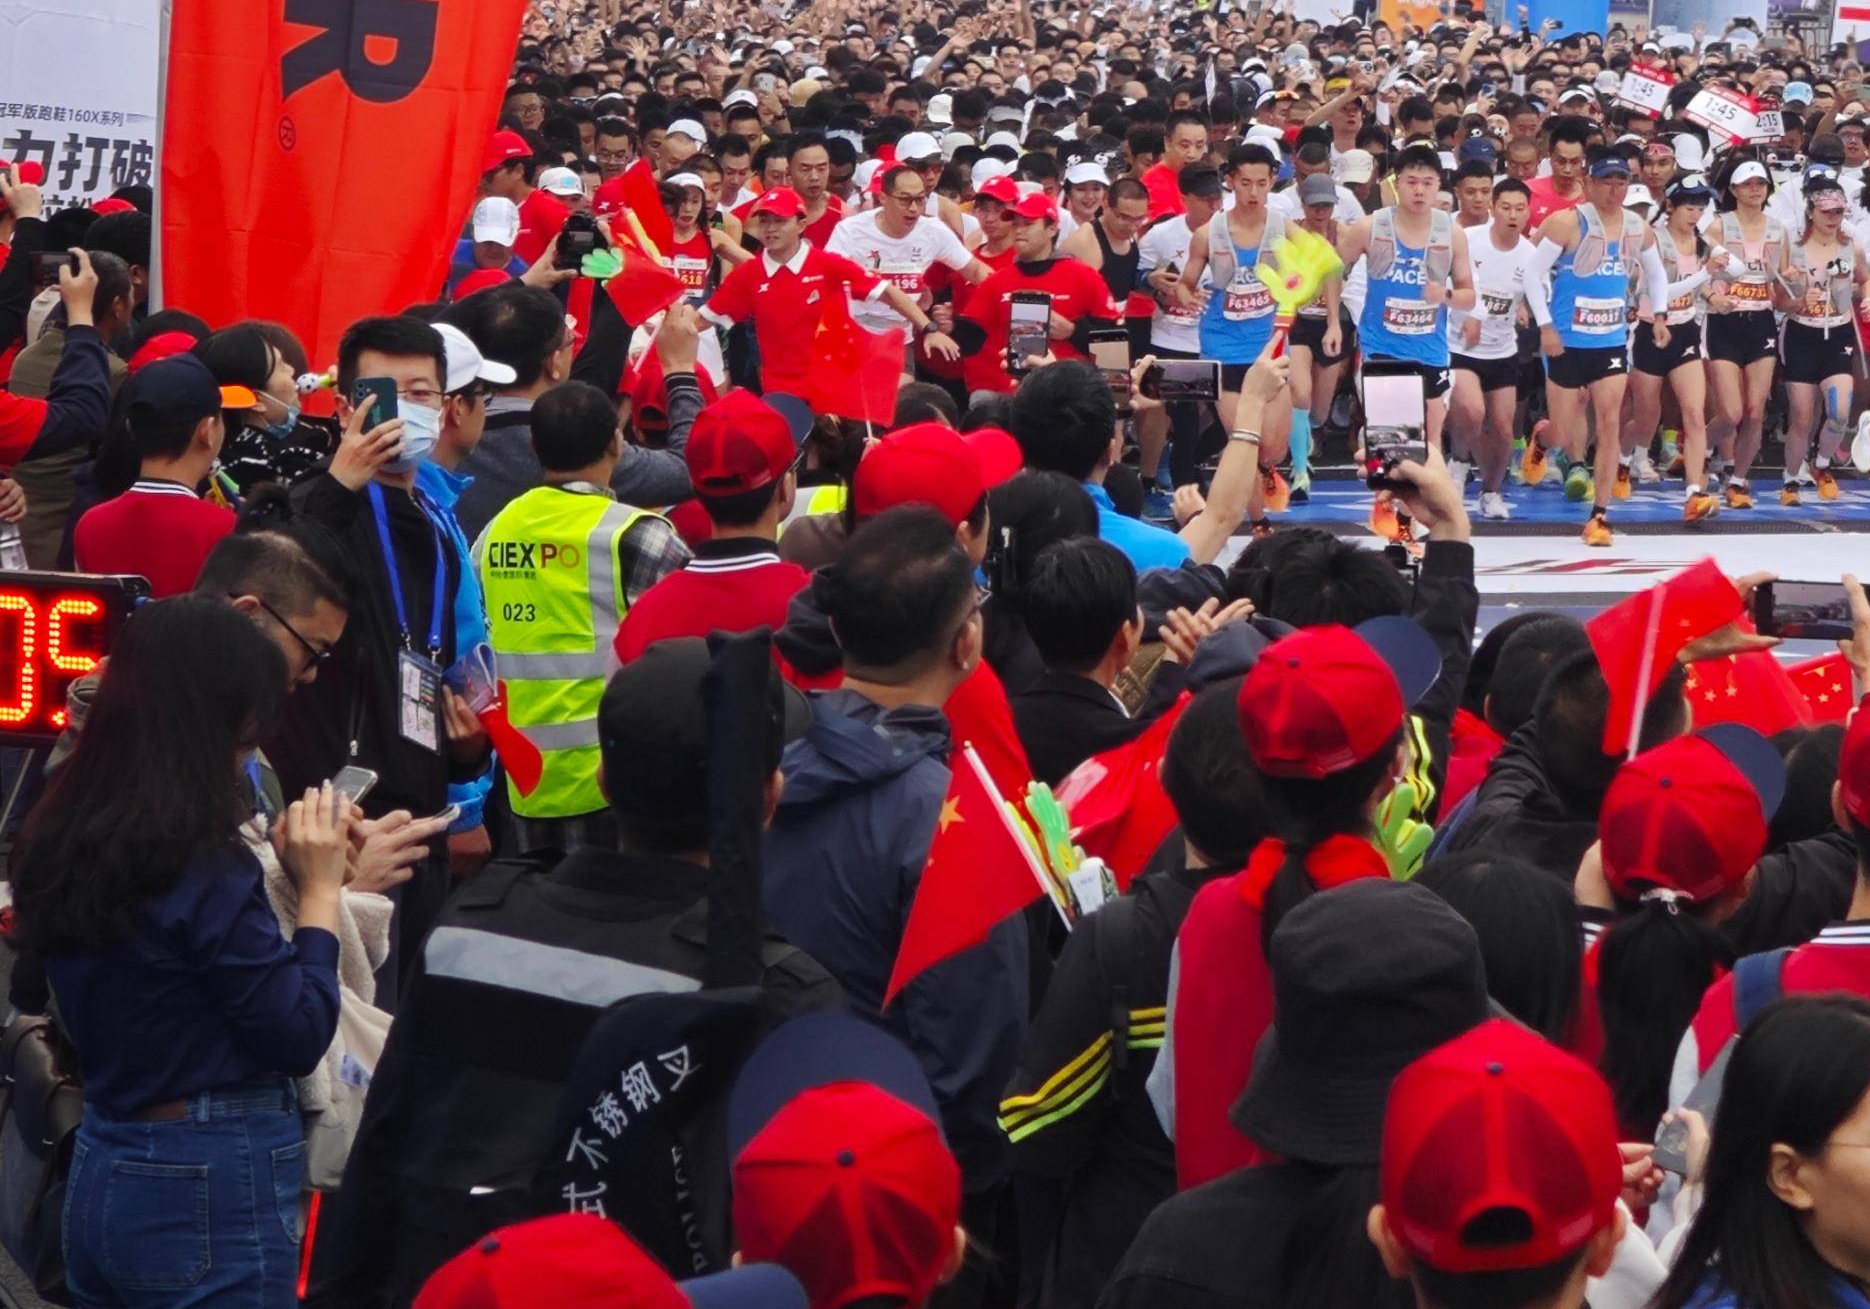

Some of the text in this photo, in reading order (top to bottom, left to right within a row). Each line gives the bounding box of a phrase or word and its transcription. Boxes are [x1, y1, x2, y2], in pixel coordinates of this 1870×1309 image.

[1705, 96, 1738, 121] 1:45
[1755, 113, 1779, 129] 2:15
[1386, 269, 1427, 286] PACE
[1389, 308, 1433, 324] F63464
[502, 602, 537, 623] 023
